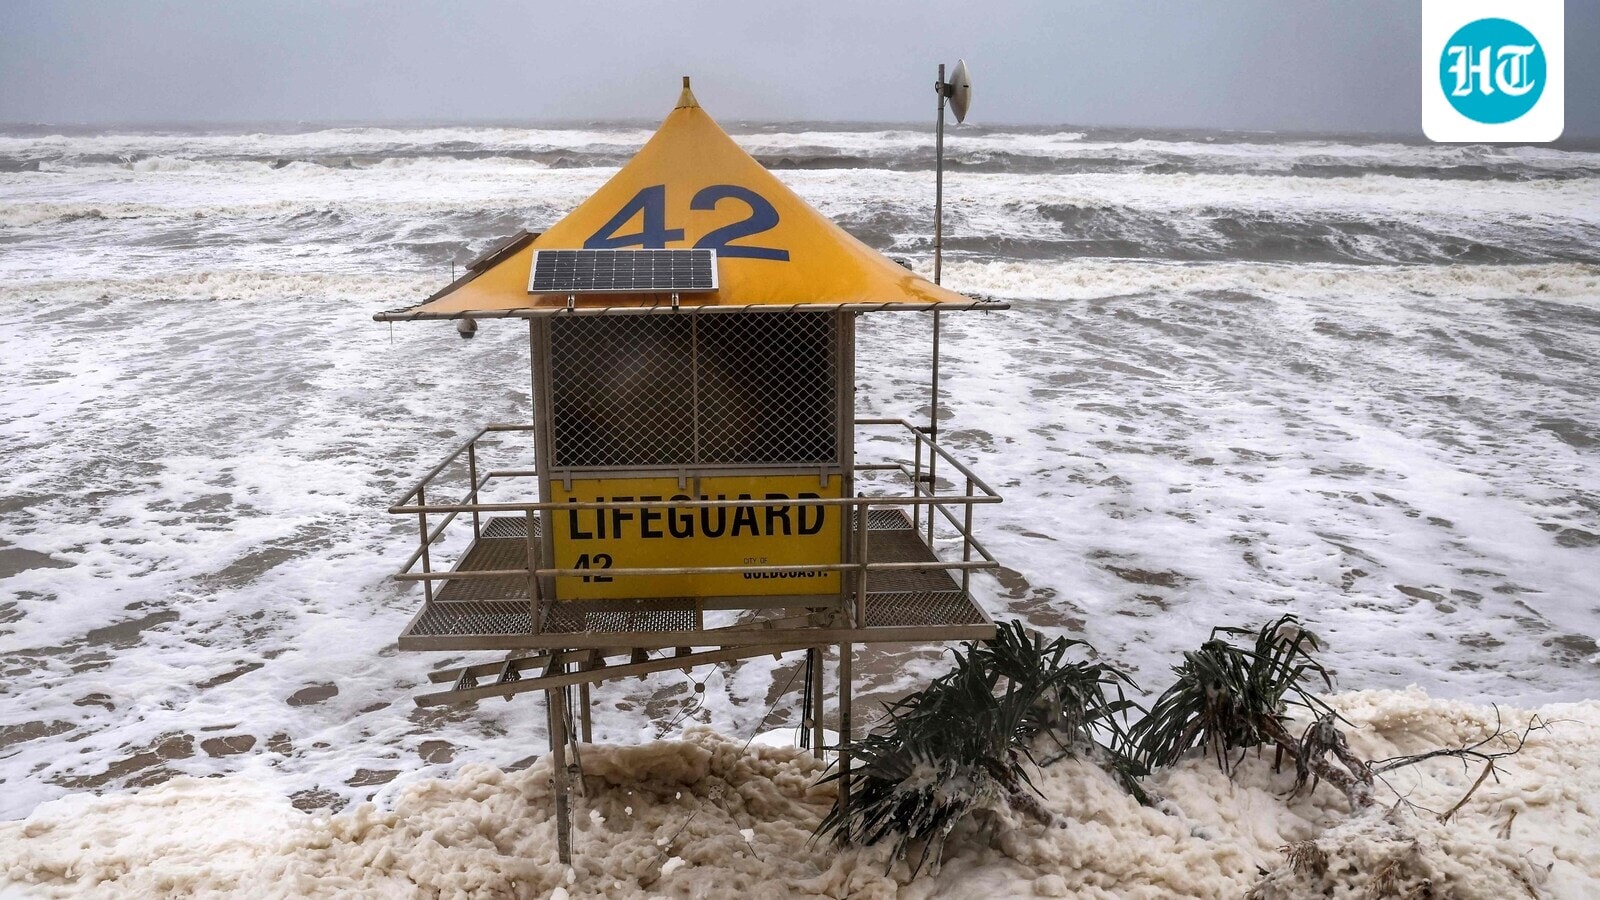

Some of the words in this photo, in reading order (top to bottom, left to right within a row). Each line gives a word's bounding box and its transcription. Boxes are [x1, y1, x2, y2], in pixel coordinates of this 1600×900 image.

[584, 184, 790, 261] 42
[568, 492, 825, 540] LIFEGUARD
[572, 553, 613, 583] 42
